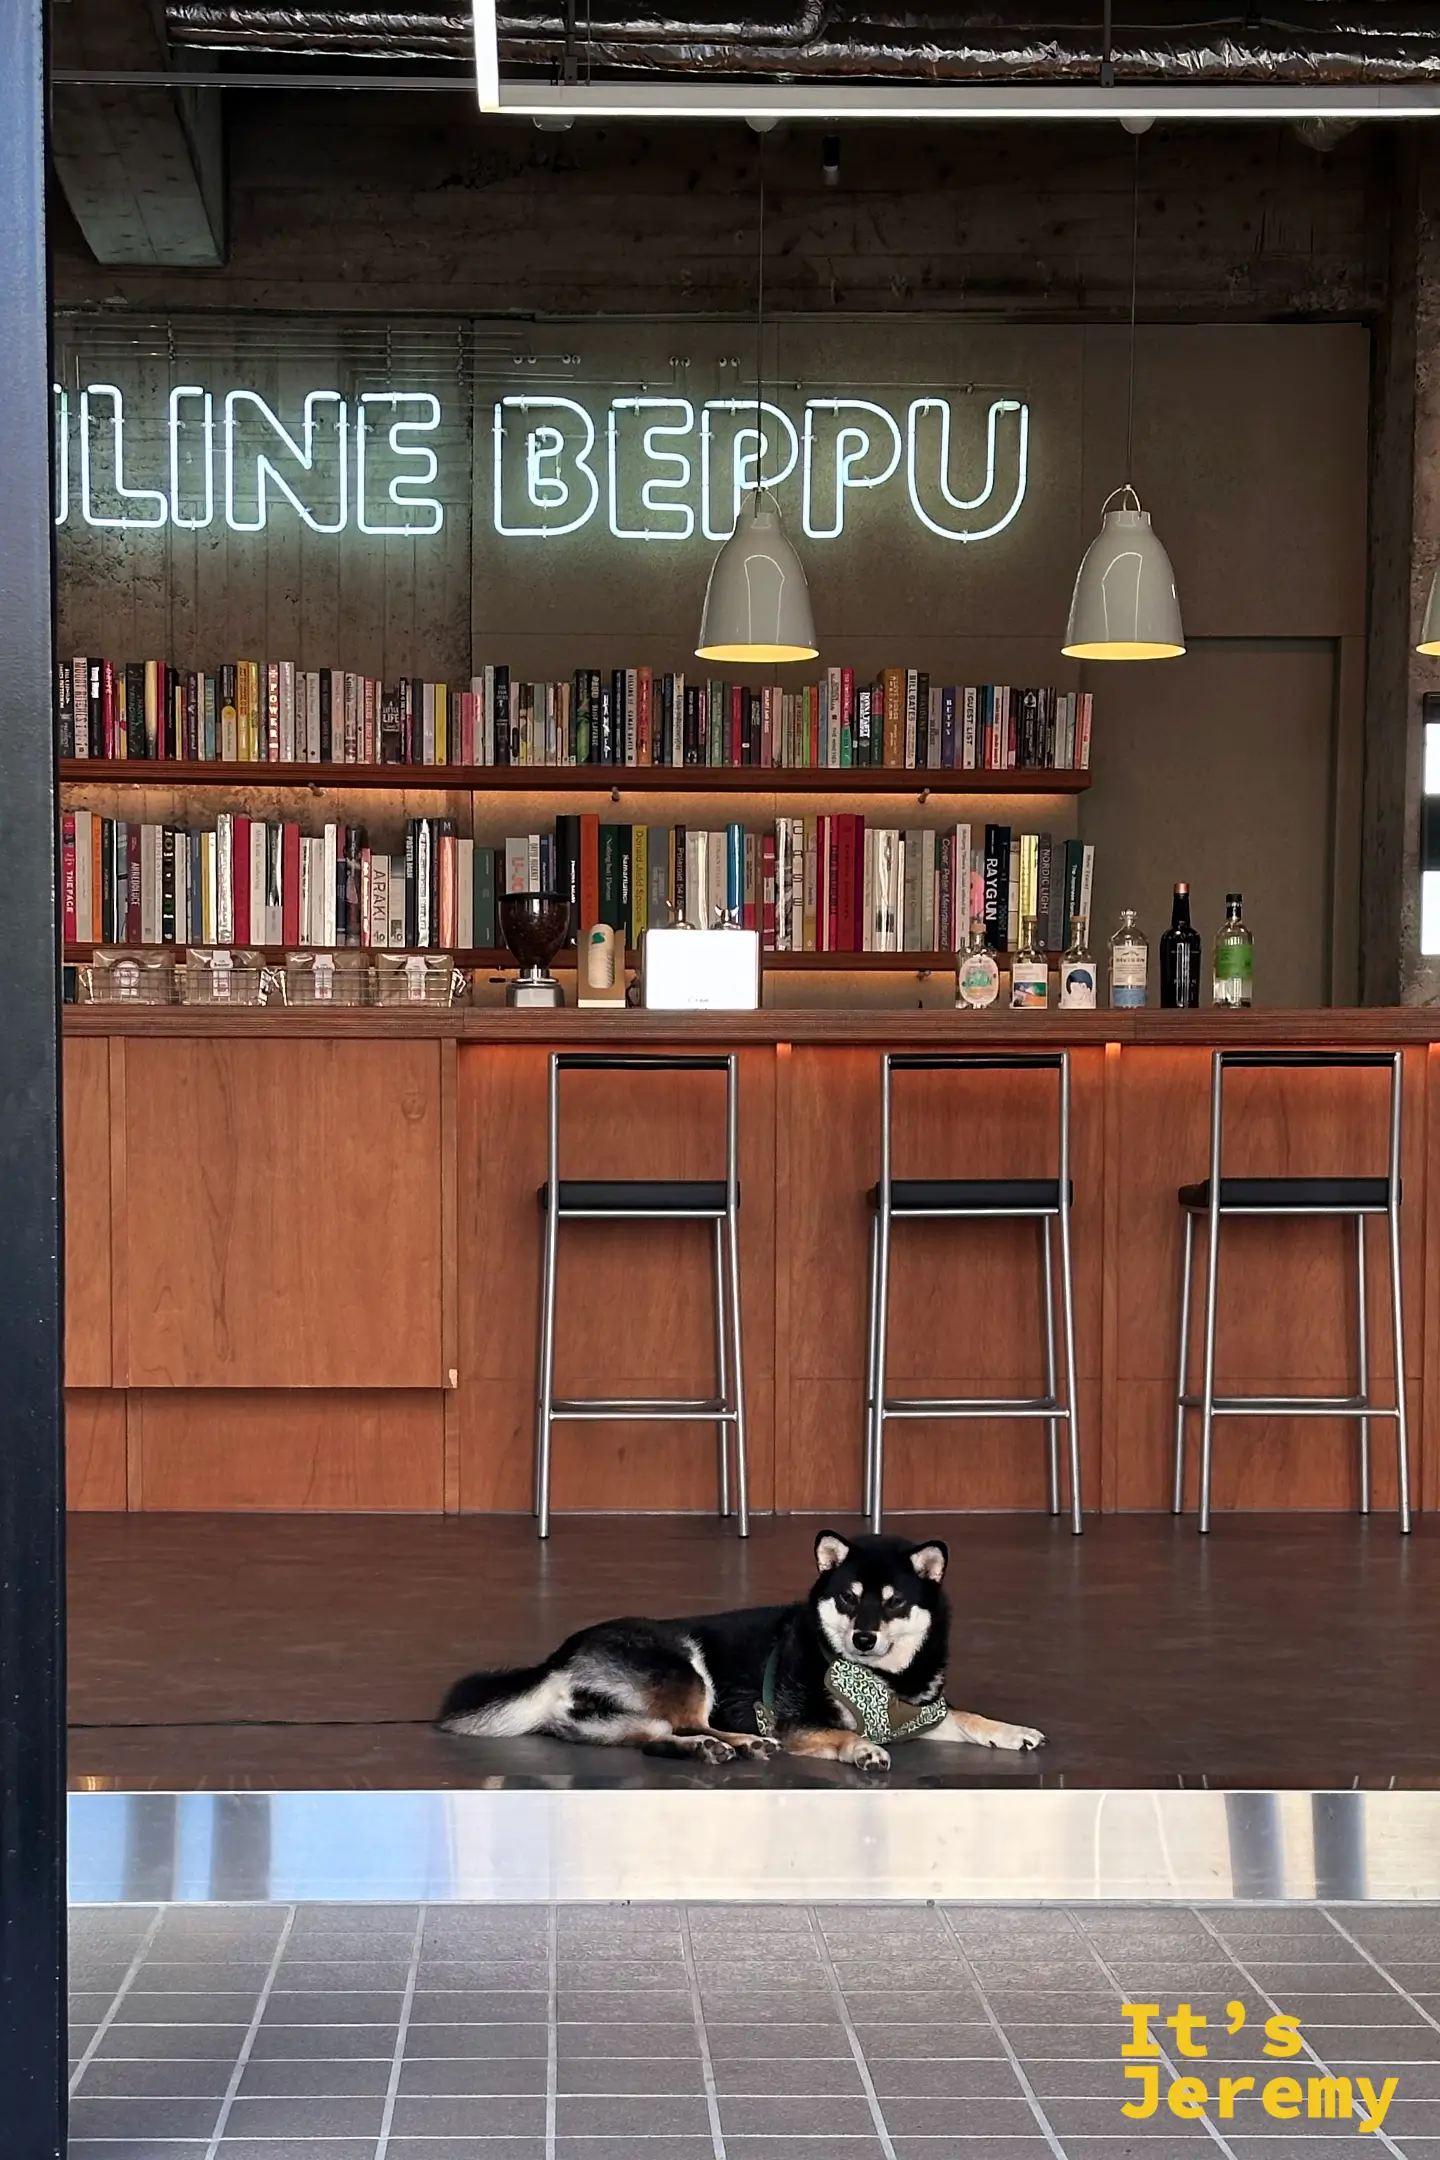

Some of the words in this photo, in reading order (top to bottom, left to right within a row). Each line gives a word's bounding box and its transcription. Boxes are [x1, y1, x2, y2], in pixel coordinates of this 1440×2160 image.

[54, 383, 444, 537] LINE
[492, 386, 1029, 543] BEPPU
[383, 713, 400, 723] LIFE
[908, 695, 916, 722] GATES
[966, 696, 974, 725] GUEST
[635, 829, 645, 863] Donald
[530, 858, 539, 882] HOCKNEY
[635, 863, 645, 887] Judd
[676, 847, 684, 881] Polaroid
[1041, 848, 1051, 885] NORDIC
[66, 871, 74, 888] THE
[985, 858, 998, 921] RAYGUN
[66, 889, 74, 913] FACE
[373, 869, 386, 921] ARAKI
[634, 888, 645, 924] Spaces
[1040, 886, 1049, 916] LIGHT
